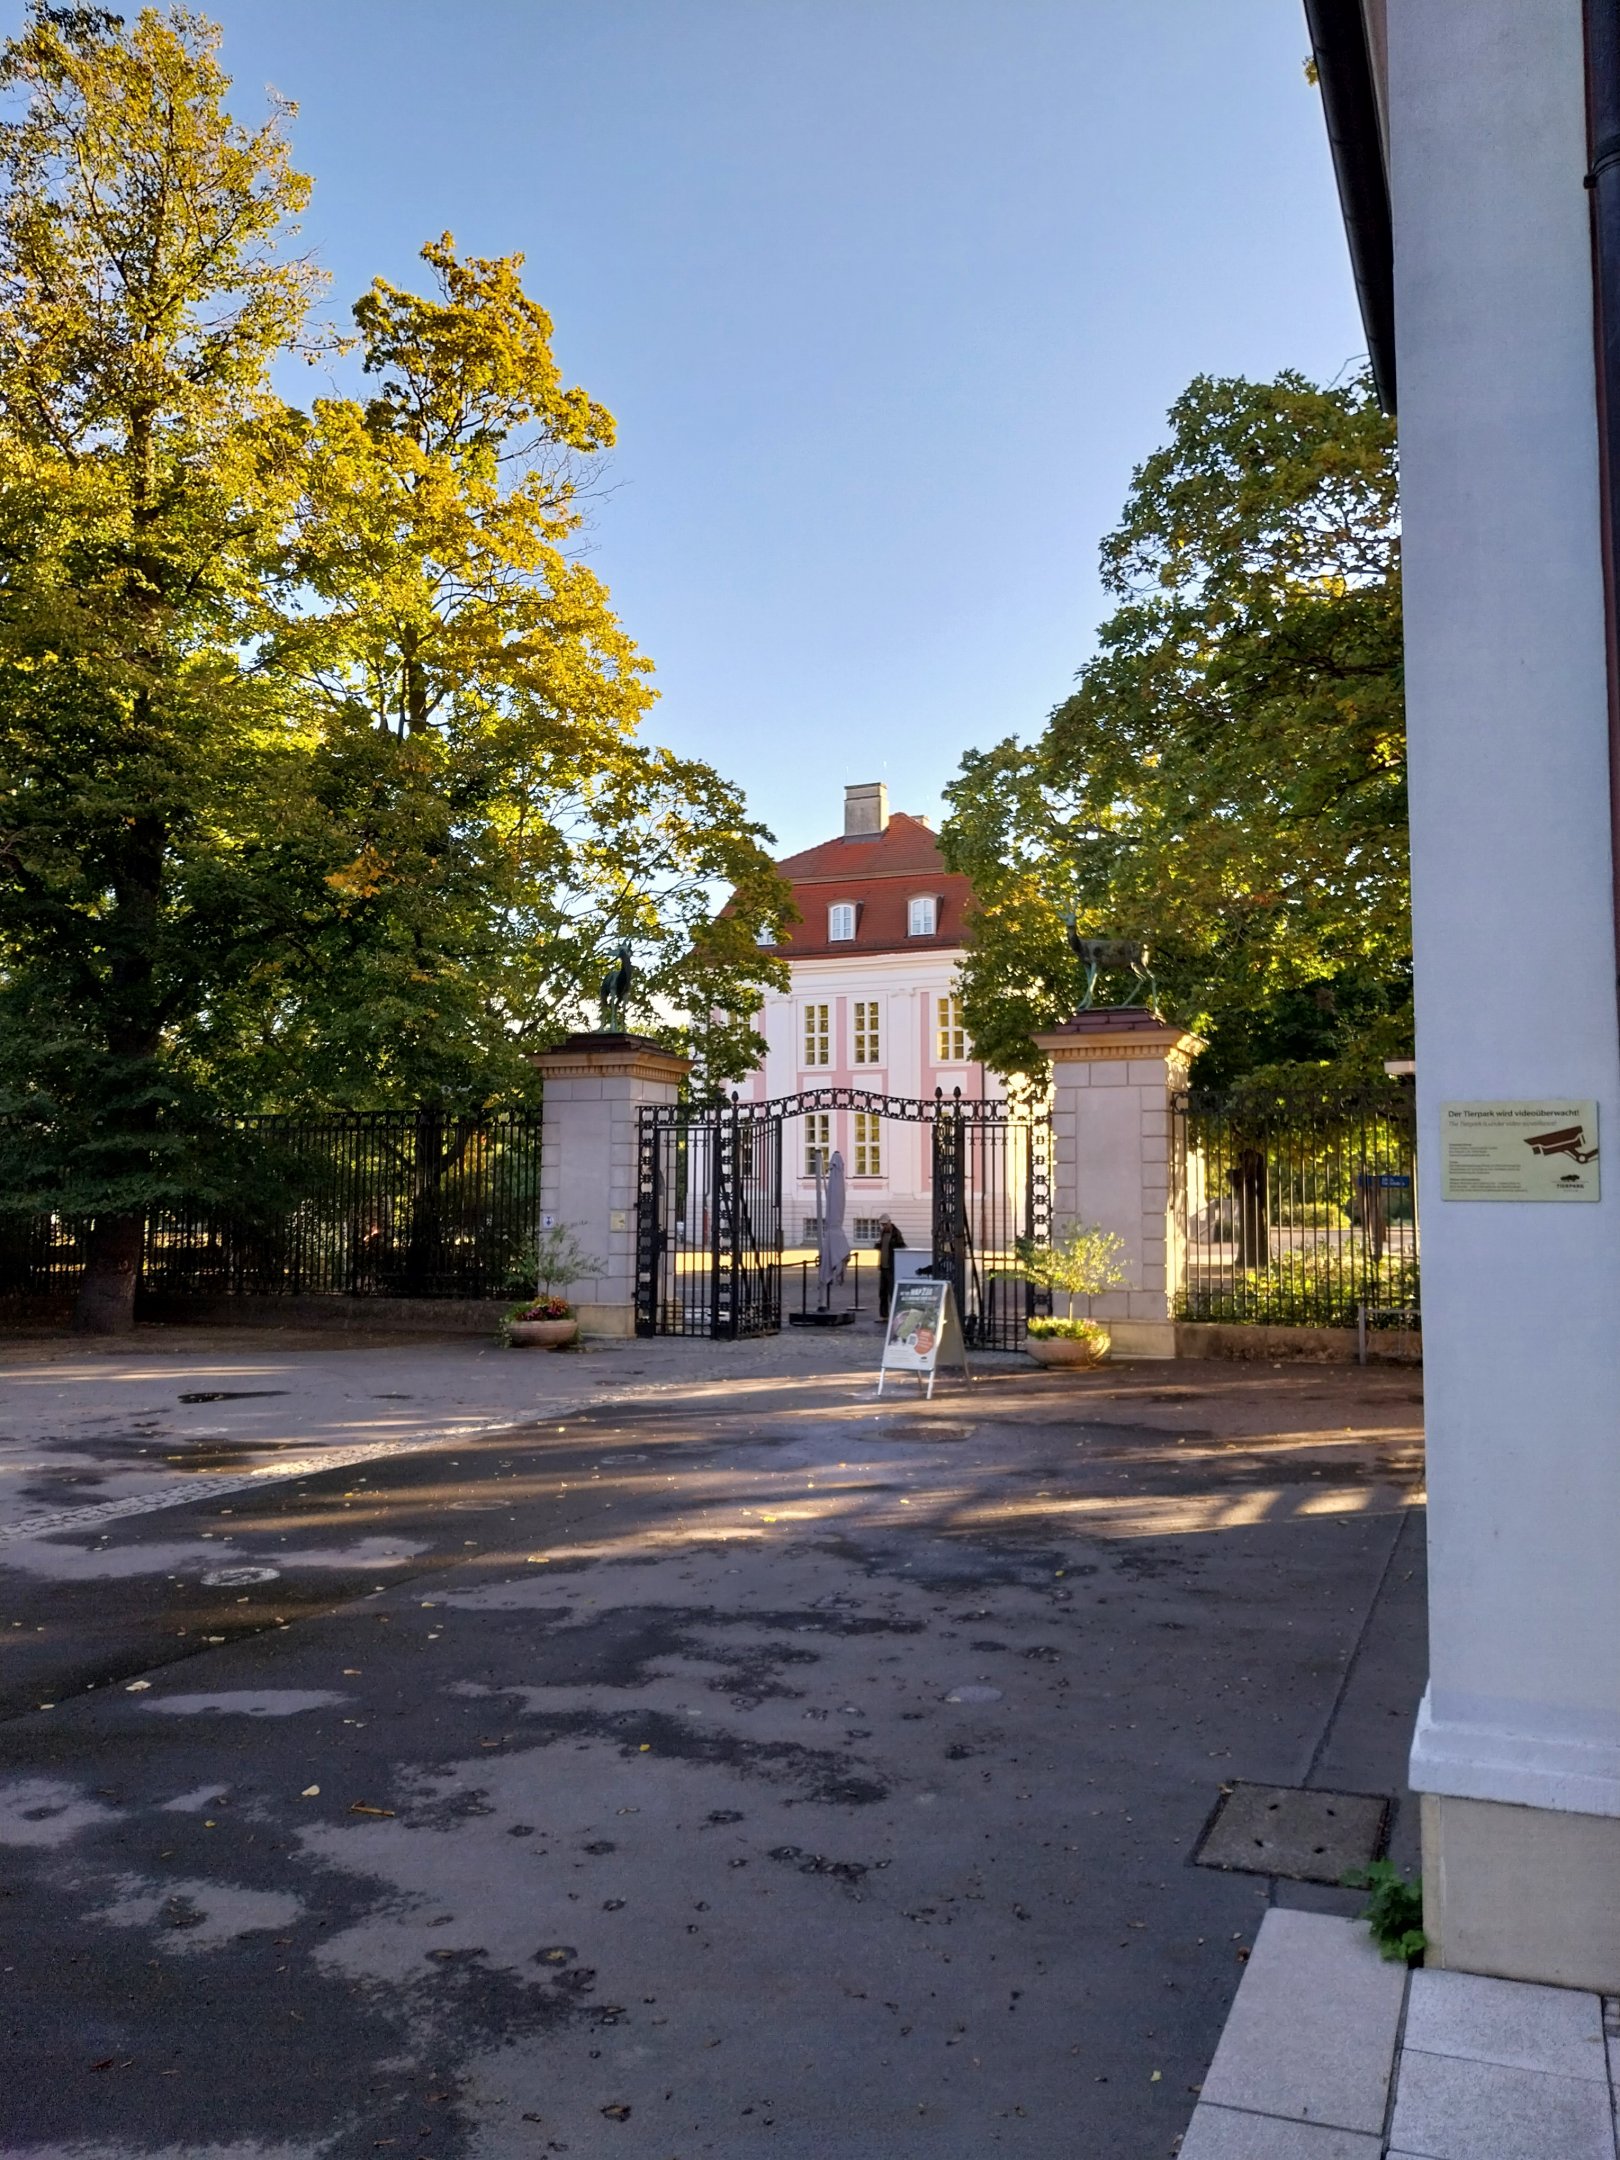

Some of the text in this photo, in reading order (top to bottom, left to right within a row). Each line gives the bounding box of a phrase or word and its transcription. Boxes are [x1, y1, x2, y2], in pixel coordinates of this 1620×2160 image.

[1448, 1109, 1579, 1119] Der Tierpark wird videoüberwacht!
